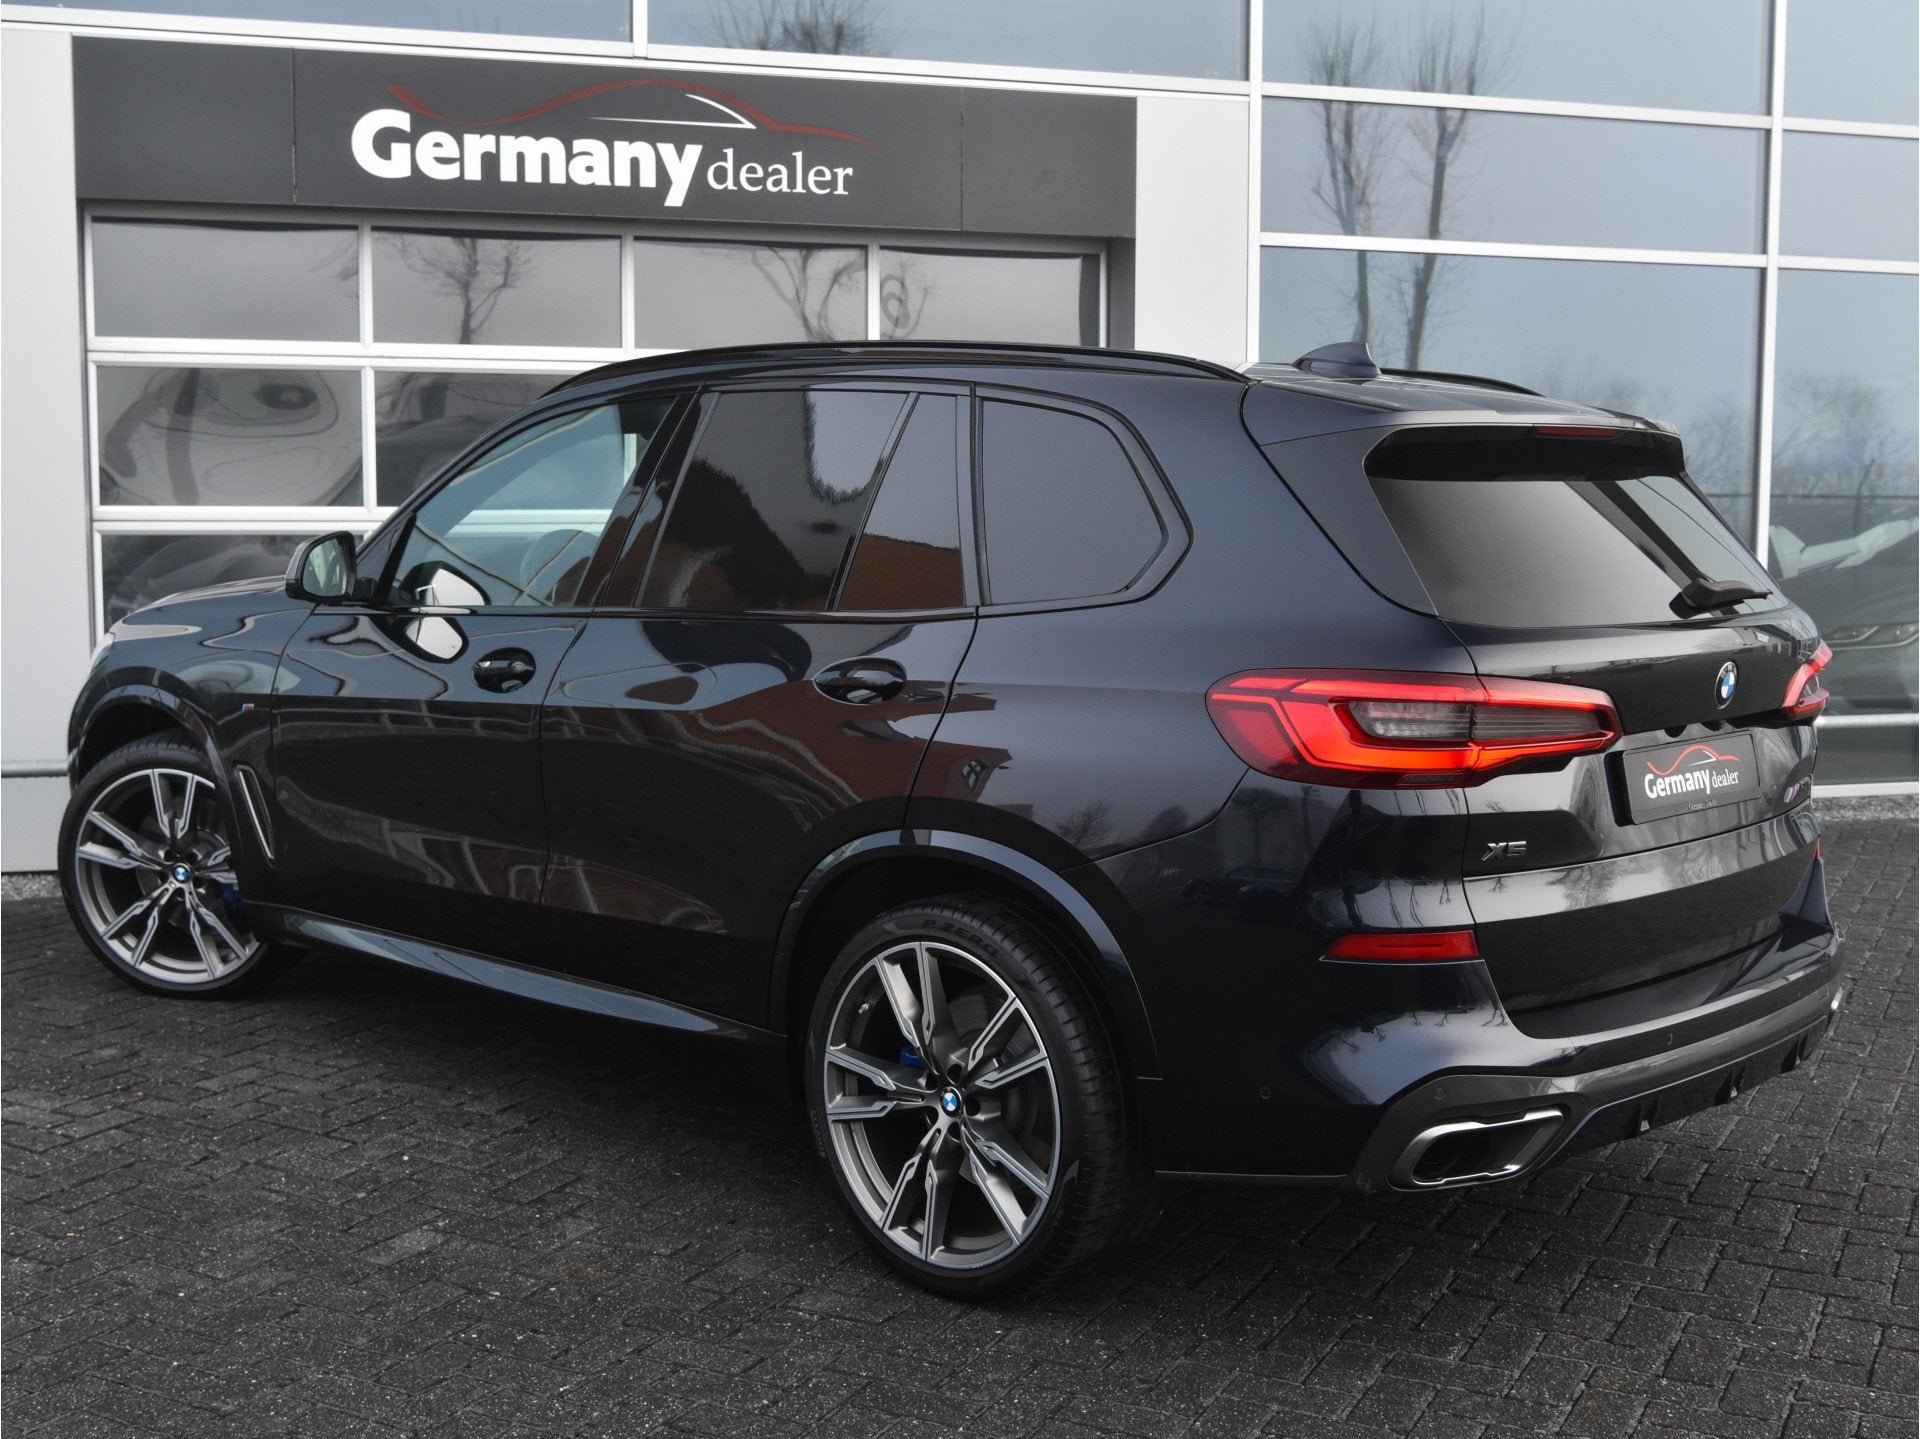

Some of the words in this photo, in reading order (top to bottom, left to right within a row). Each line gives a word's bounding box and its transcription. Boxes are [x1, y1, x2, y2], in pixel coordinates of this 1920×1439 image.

[351, 108, 703, 207] Germany
[706, 148, 854, 196] dealer
[1644, 768, 1710, 799] Germany
[1711, 769, 1739, 788] dealer
[1481, 840, 1527, 861] X5
[940, 921, 999, 957] ZERO
